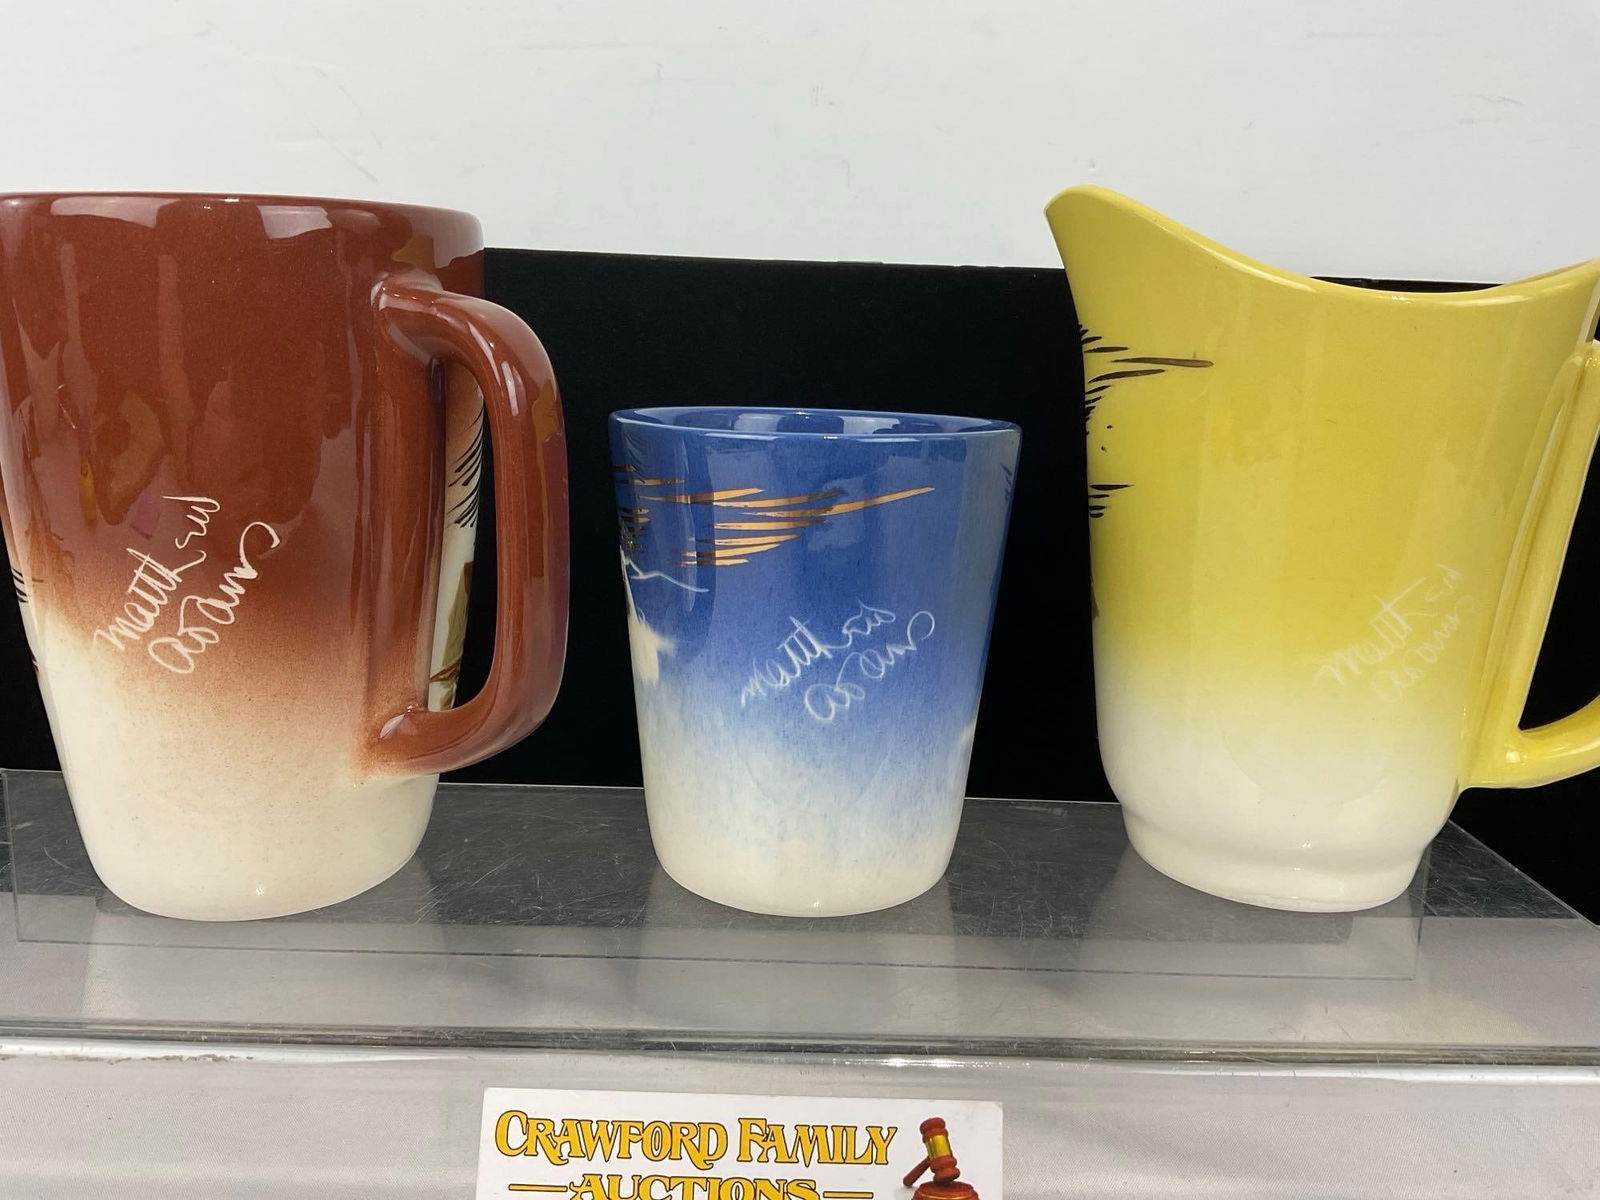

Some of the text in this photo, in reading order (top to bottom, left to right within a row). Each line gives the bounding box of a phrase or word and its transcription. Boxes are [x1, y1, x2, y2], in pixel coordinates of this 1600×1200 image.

[495, 1109, 899, 1171] CRAWFORD FAMILY
[568, 1173, 821, 1200] AUCTIONS
